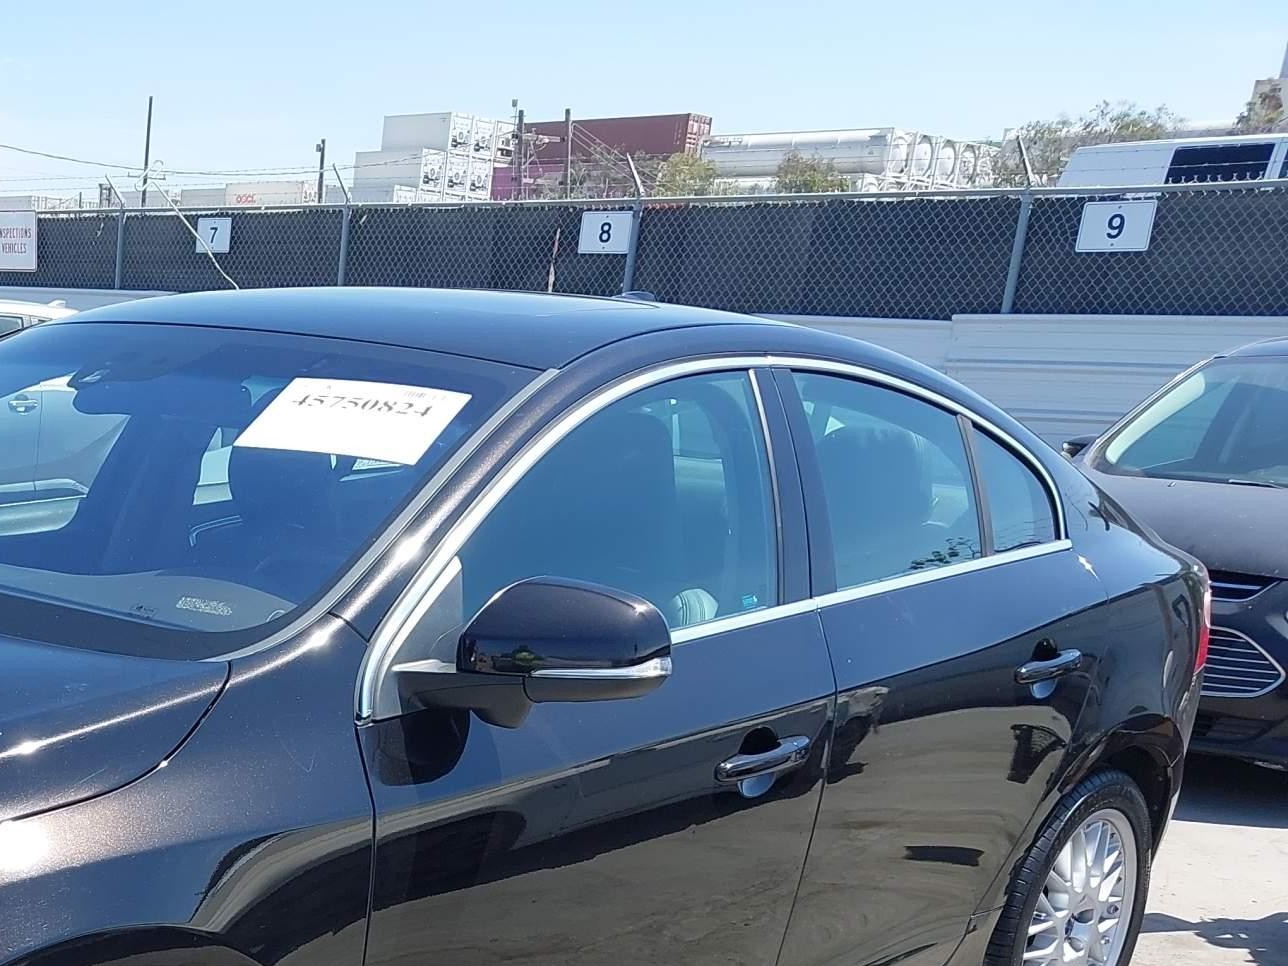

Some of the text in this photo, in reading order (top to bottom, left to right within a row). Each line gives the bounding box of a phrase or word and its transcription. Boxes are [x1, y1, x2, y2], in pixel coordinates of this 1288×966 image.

[209, 226, 219, 244] 7
[598, 221, 612, 244] 8
[1106, 213, 1126, 240] 9
[1, 242, 27, 254] VEHICLES
[291, 393, 434, 417] 45750824
